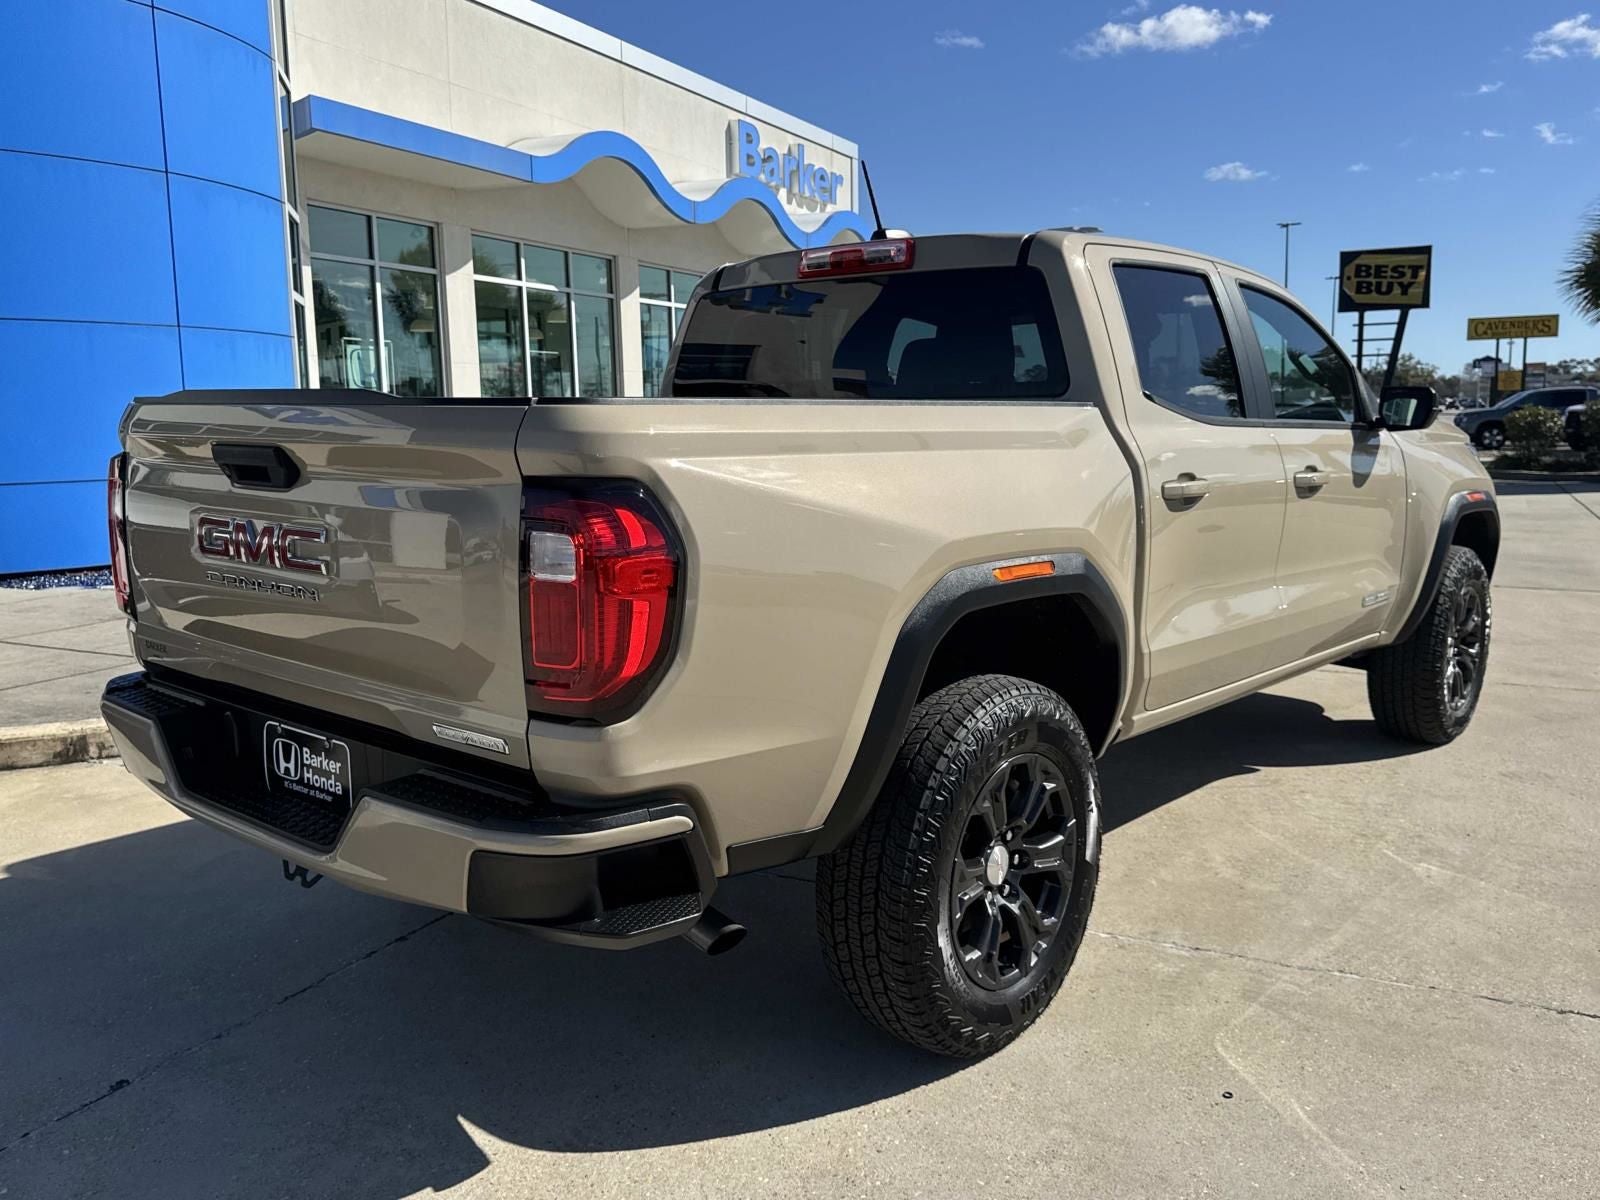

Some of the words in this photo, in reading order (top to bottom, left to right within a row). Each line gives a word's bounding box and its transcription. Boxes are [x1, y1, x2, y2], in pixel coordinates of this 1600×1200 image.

[736, 118, 844, 205] Barker
[1354, 264, 1425, 280] BEST
[1355, 280, 1417, 296] BUY
[198, 516, 328, 575] GMC
[206, 570, 321, 602] CANYON
[302, 746, 342, 775] Barker
[303, 766, 343, 795] Honda
